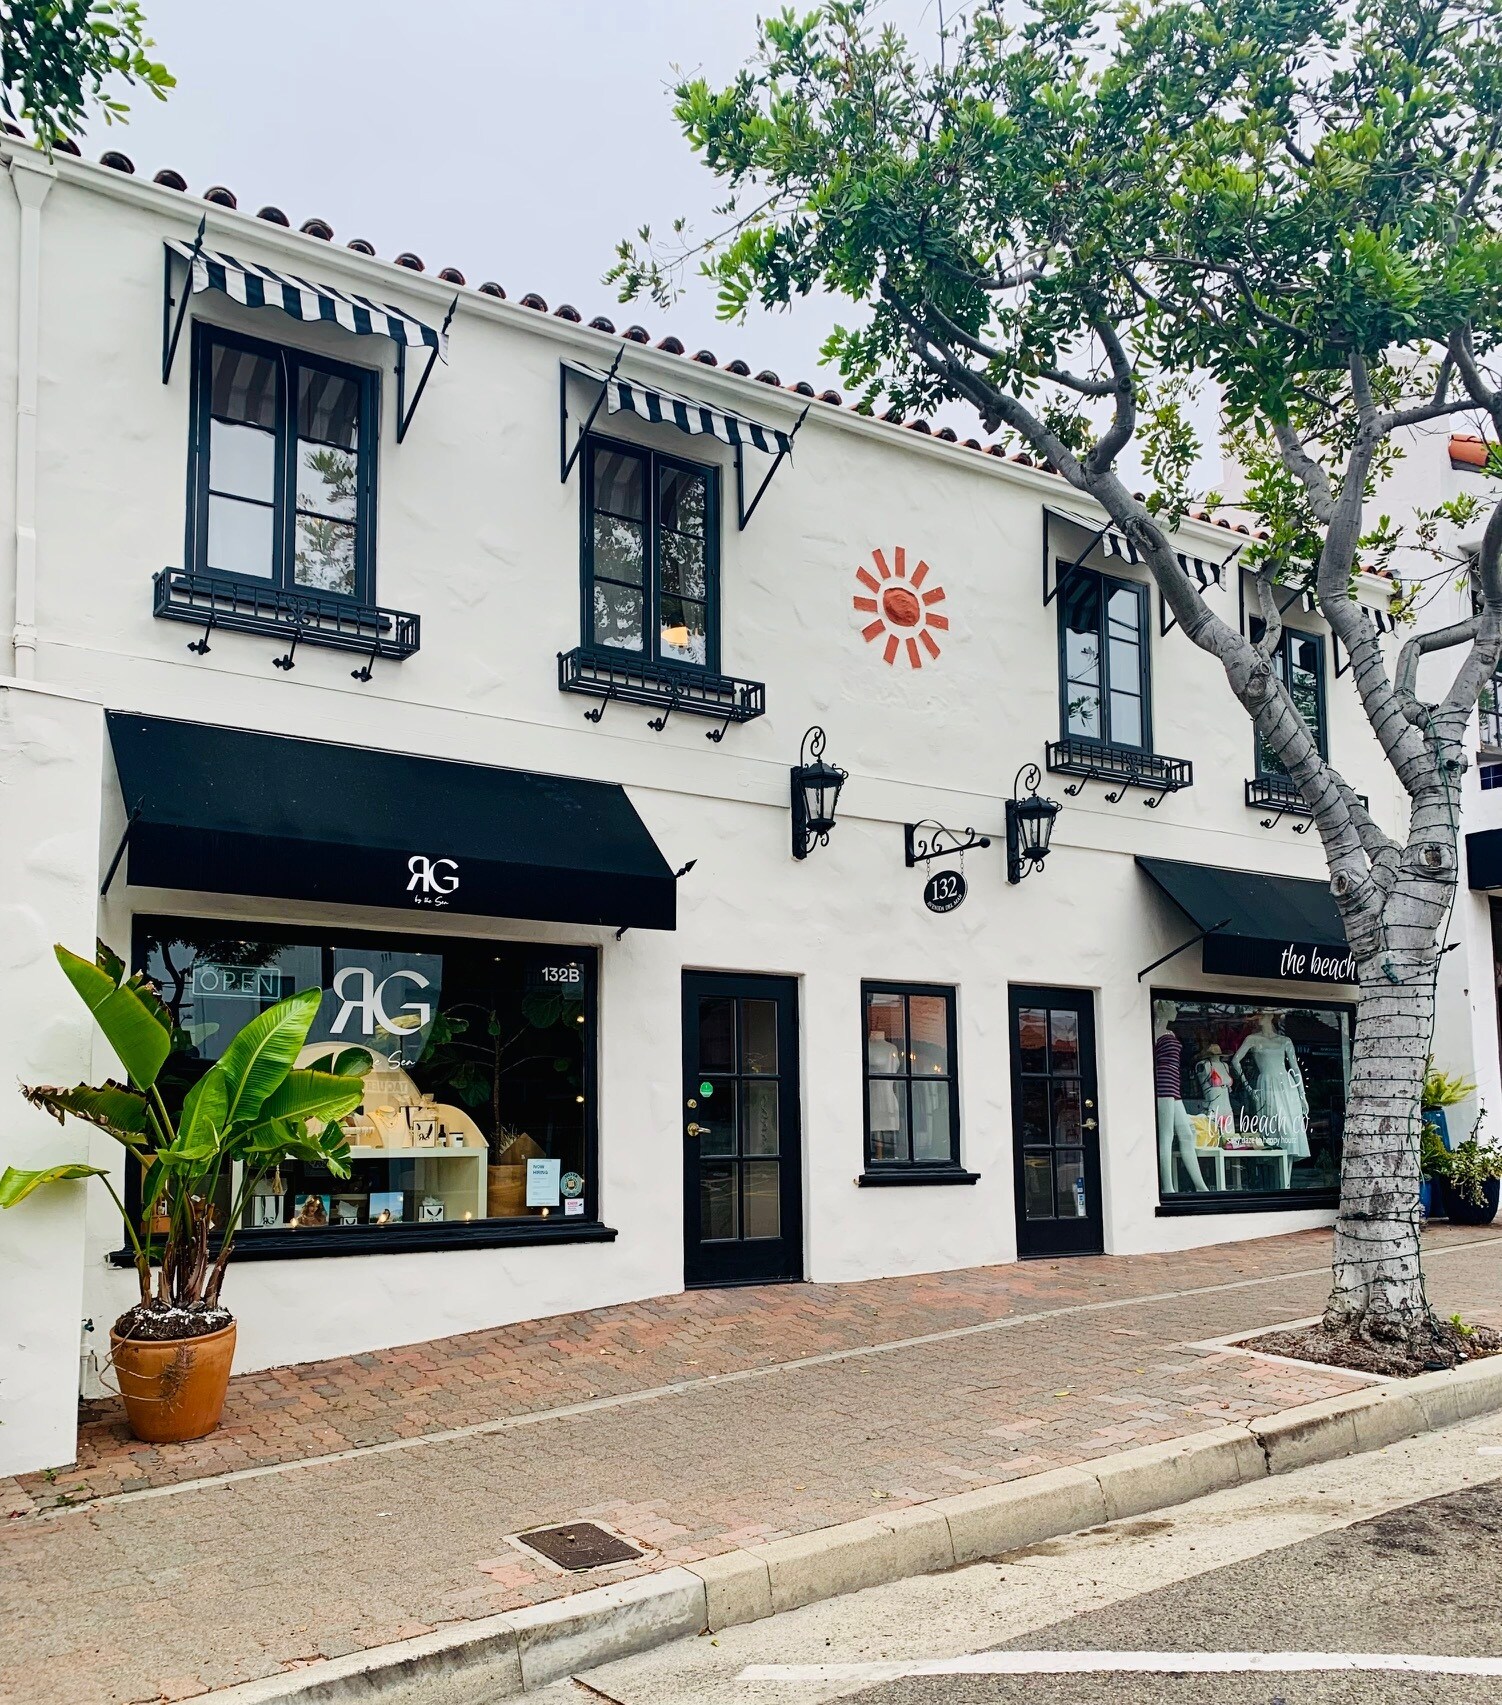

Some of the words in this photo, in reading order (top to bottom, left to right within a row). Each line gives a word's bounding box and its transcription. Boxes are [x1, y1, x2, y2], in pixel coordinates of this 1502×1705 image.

[932, 876, 958, 901] 132
[541, 966, 580, 983] 132B
[1280, 943, 1306, 976] the
[1310, 946, 1356, 981] beach
[200, 970, 274, 994] OPEN
[1208, 1105, 1233, 1138] the
[1239, 1105, 1288, 1137] beach
[1292, 1113, 1314, 1134] co.
